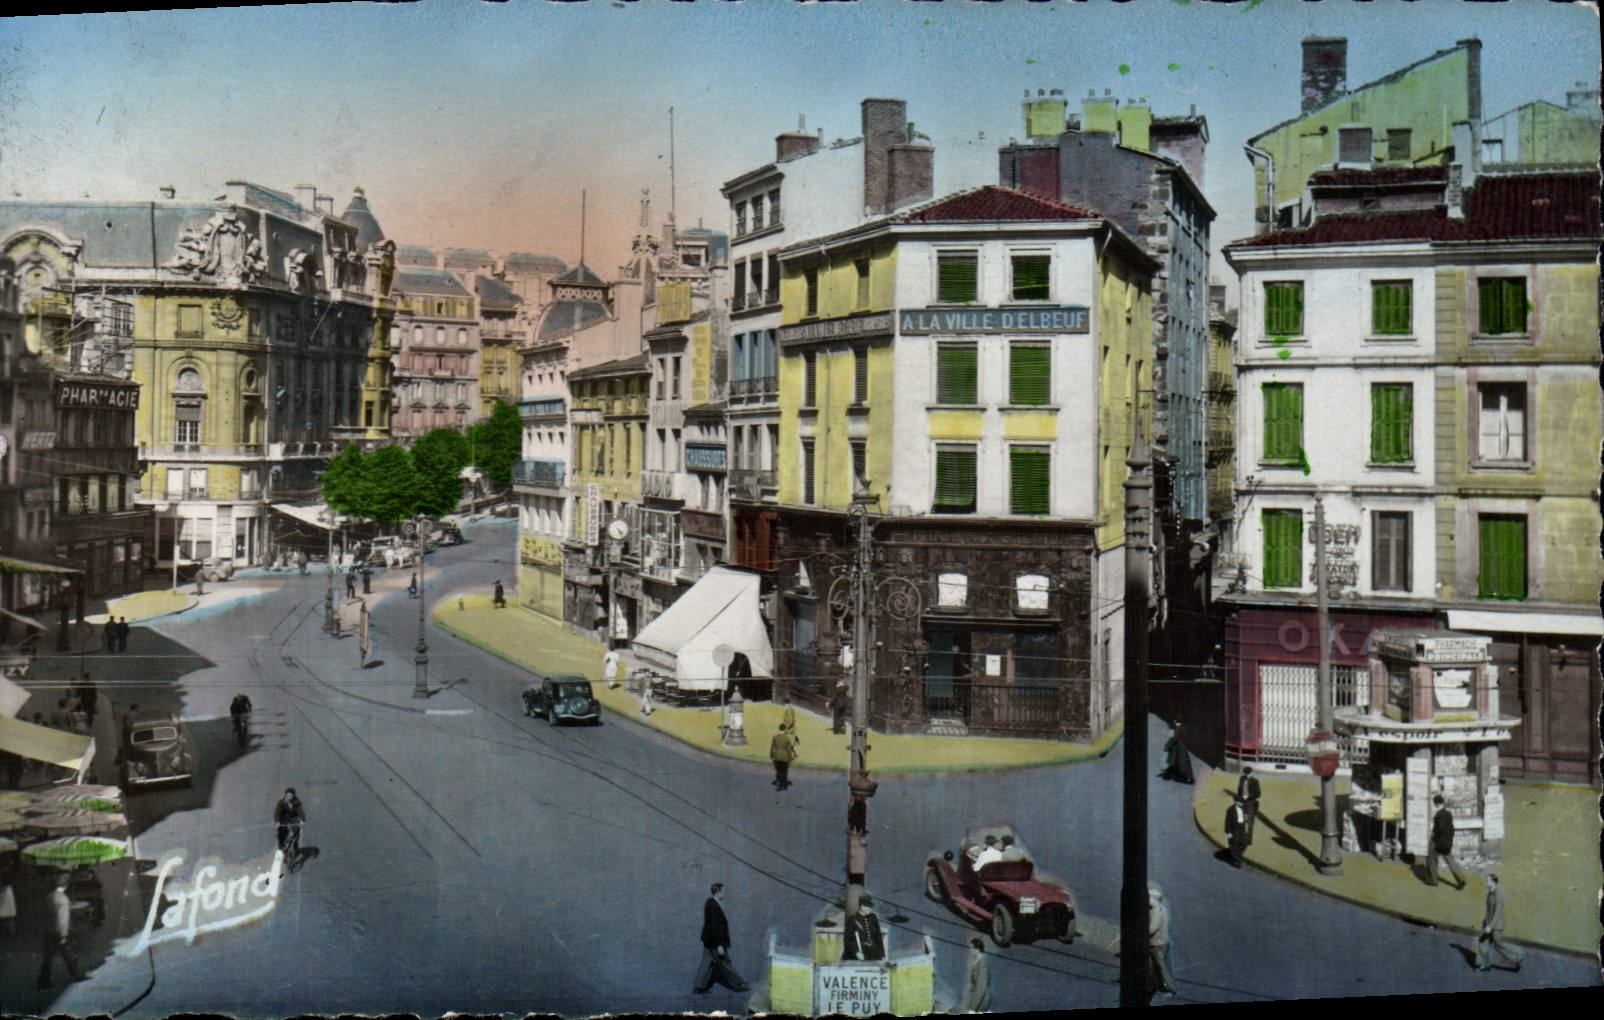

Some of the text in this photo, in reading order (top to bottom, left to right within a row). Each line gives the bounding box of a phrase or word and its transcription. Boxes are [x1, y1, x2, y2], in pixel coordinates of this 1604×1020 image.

[902, 314, 915, 331] A
[919, 314, 941, 331] LA
[945, 312, 993, 330] VILLE
[1002, 311, 1088, 329] D'ELBEUF
[823, 976, 888, 989] VALENCE
[831, 990, 879, 1000] FIRMINY
[852, 1002, 881, 1014] PUY
